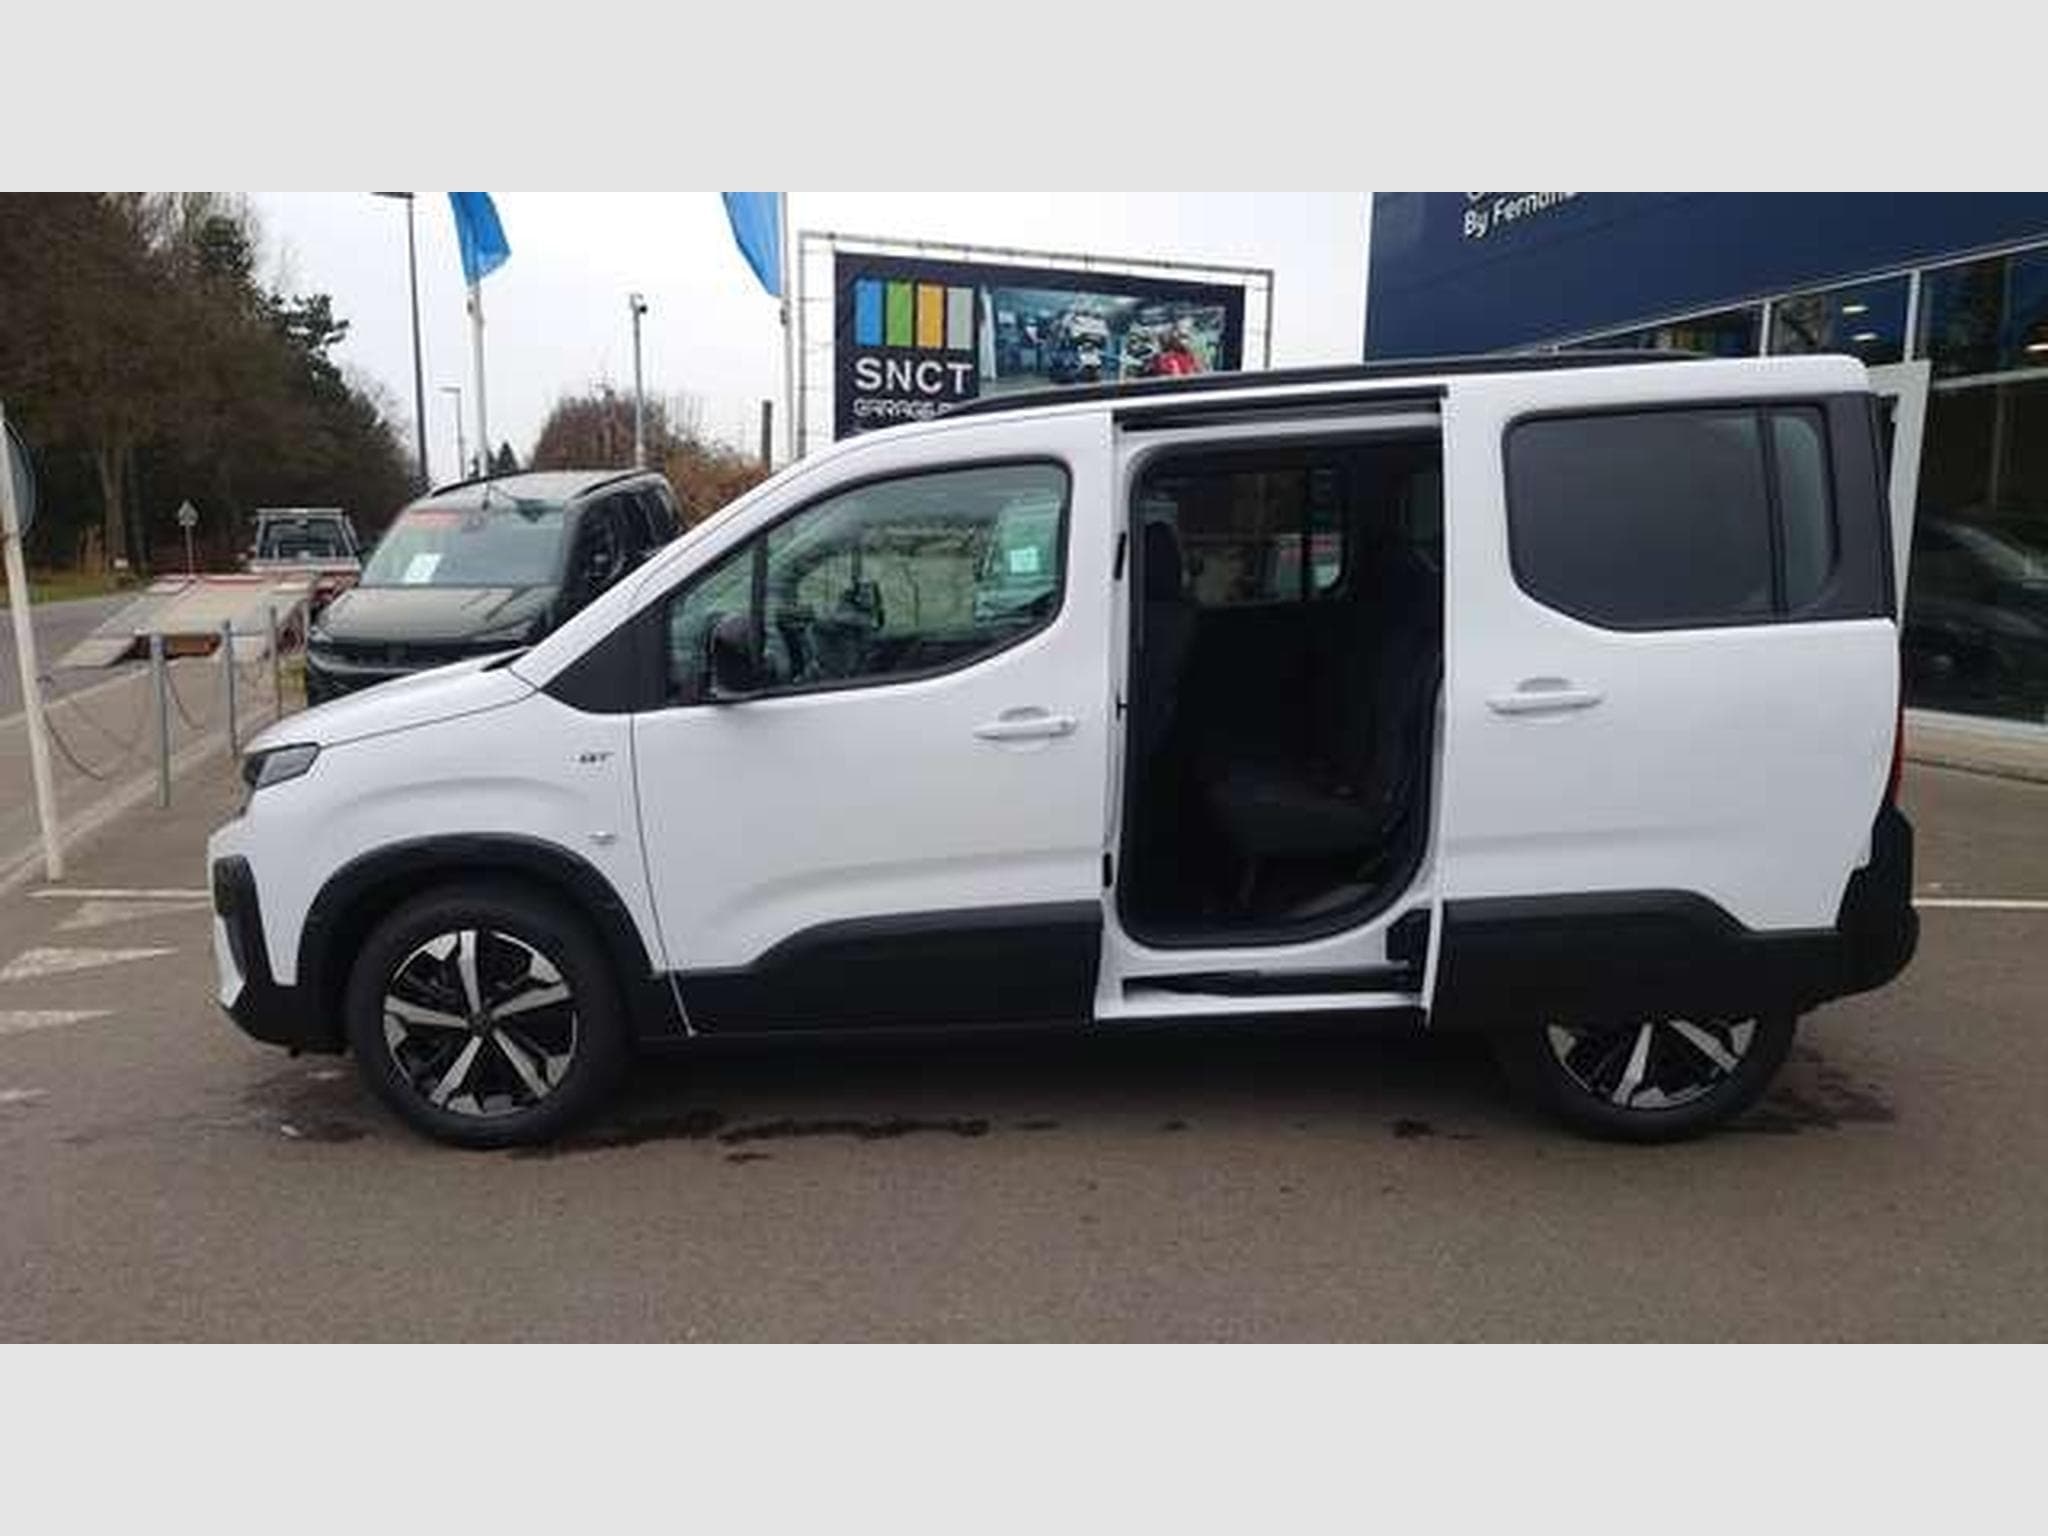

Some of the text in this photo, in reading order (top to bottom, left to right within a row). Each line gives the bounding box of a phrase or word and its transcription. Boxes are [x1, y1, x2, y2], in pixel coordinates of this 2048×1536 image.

[1463, 192, 1577, 238] By Fernan
[854, 356, 974, 395] SNCT
